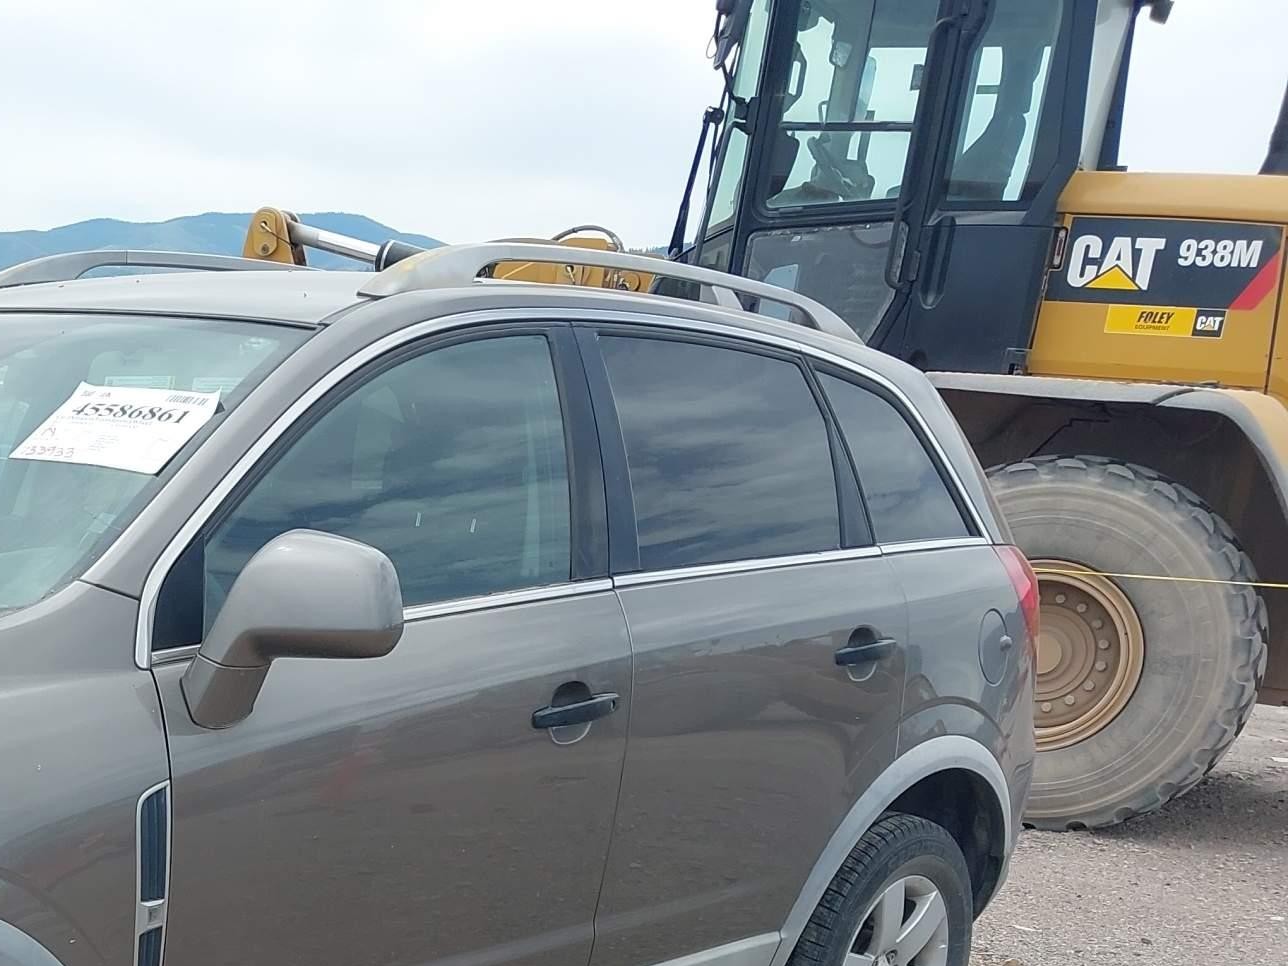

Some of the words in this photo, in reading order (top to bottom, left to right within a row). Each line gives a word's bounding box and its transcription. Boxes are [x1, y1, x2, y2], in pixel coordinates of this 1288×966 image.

[1066, 234, 1166, 290] CAT
[1177, 238, 1263, 268] 938M
[1137, 311, 1174, 324] FOLEY
[1196, 315, 1224, 331] CAT
[72, 402, 190, 424] 45586861
